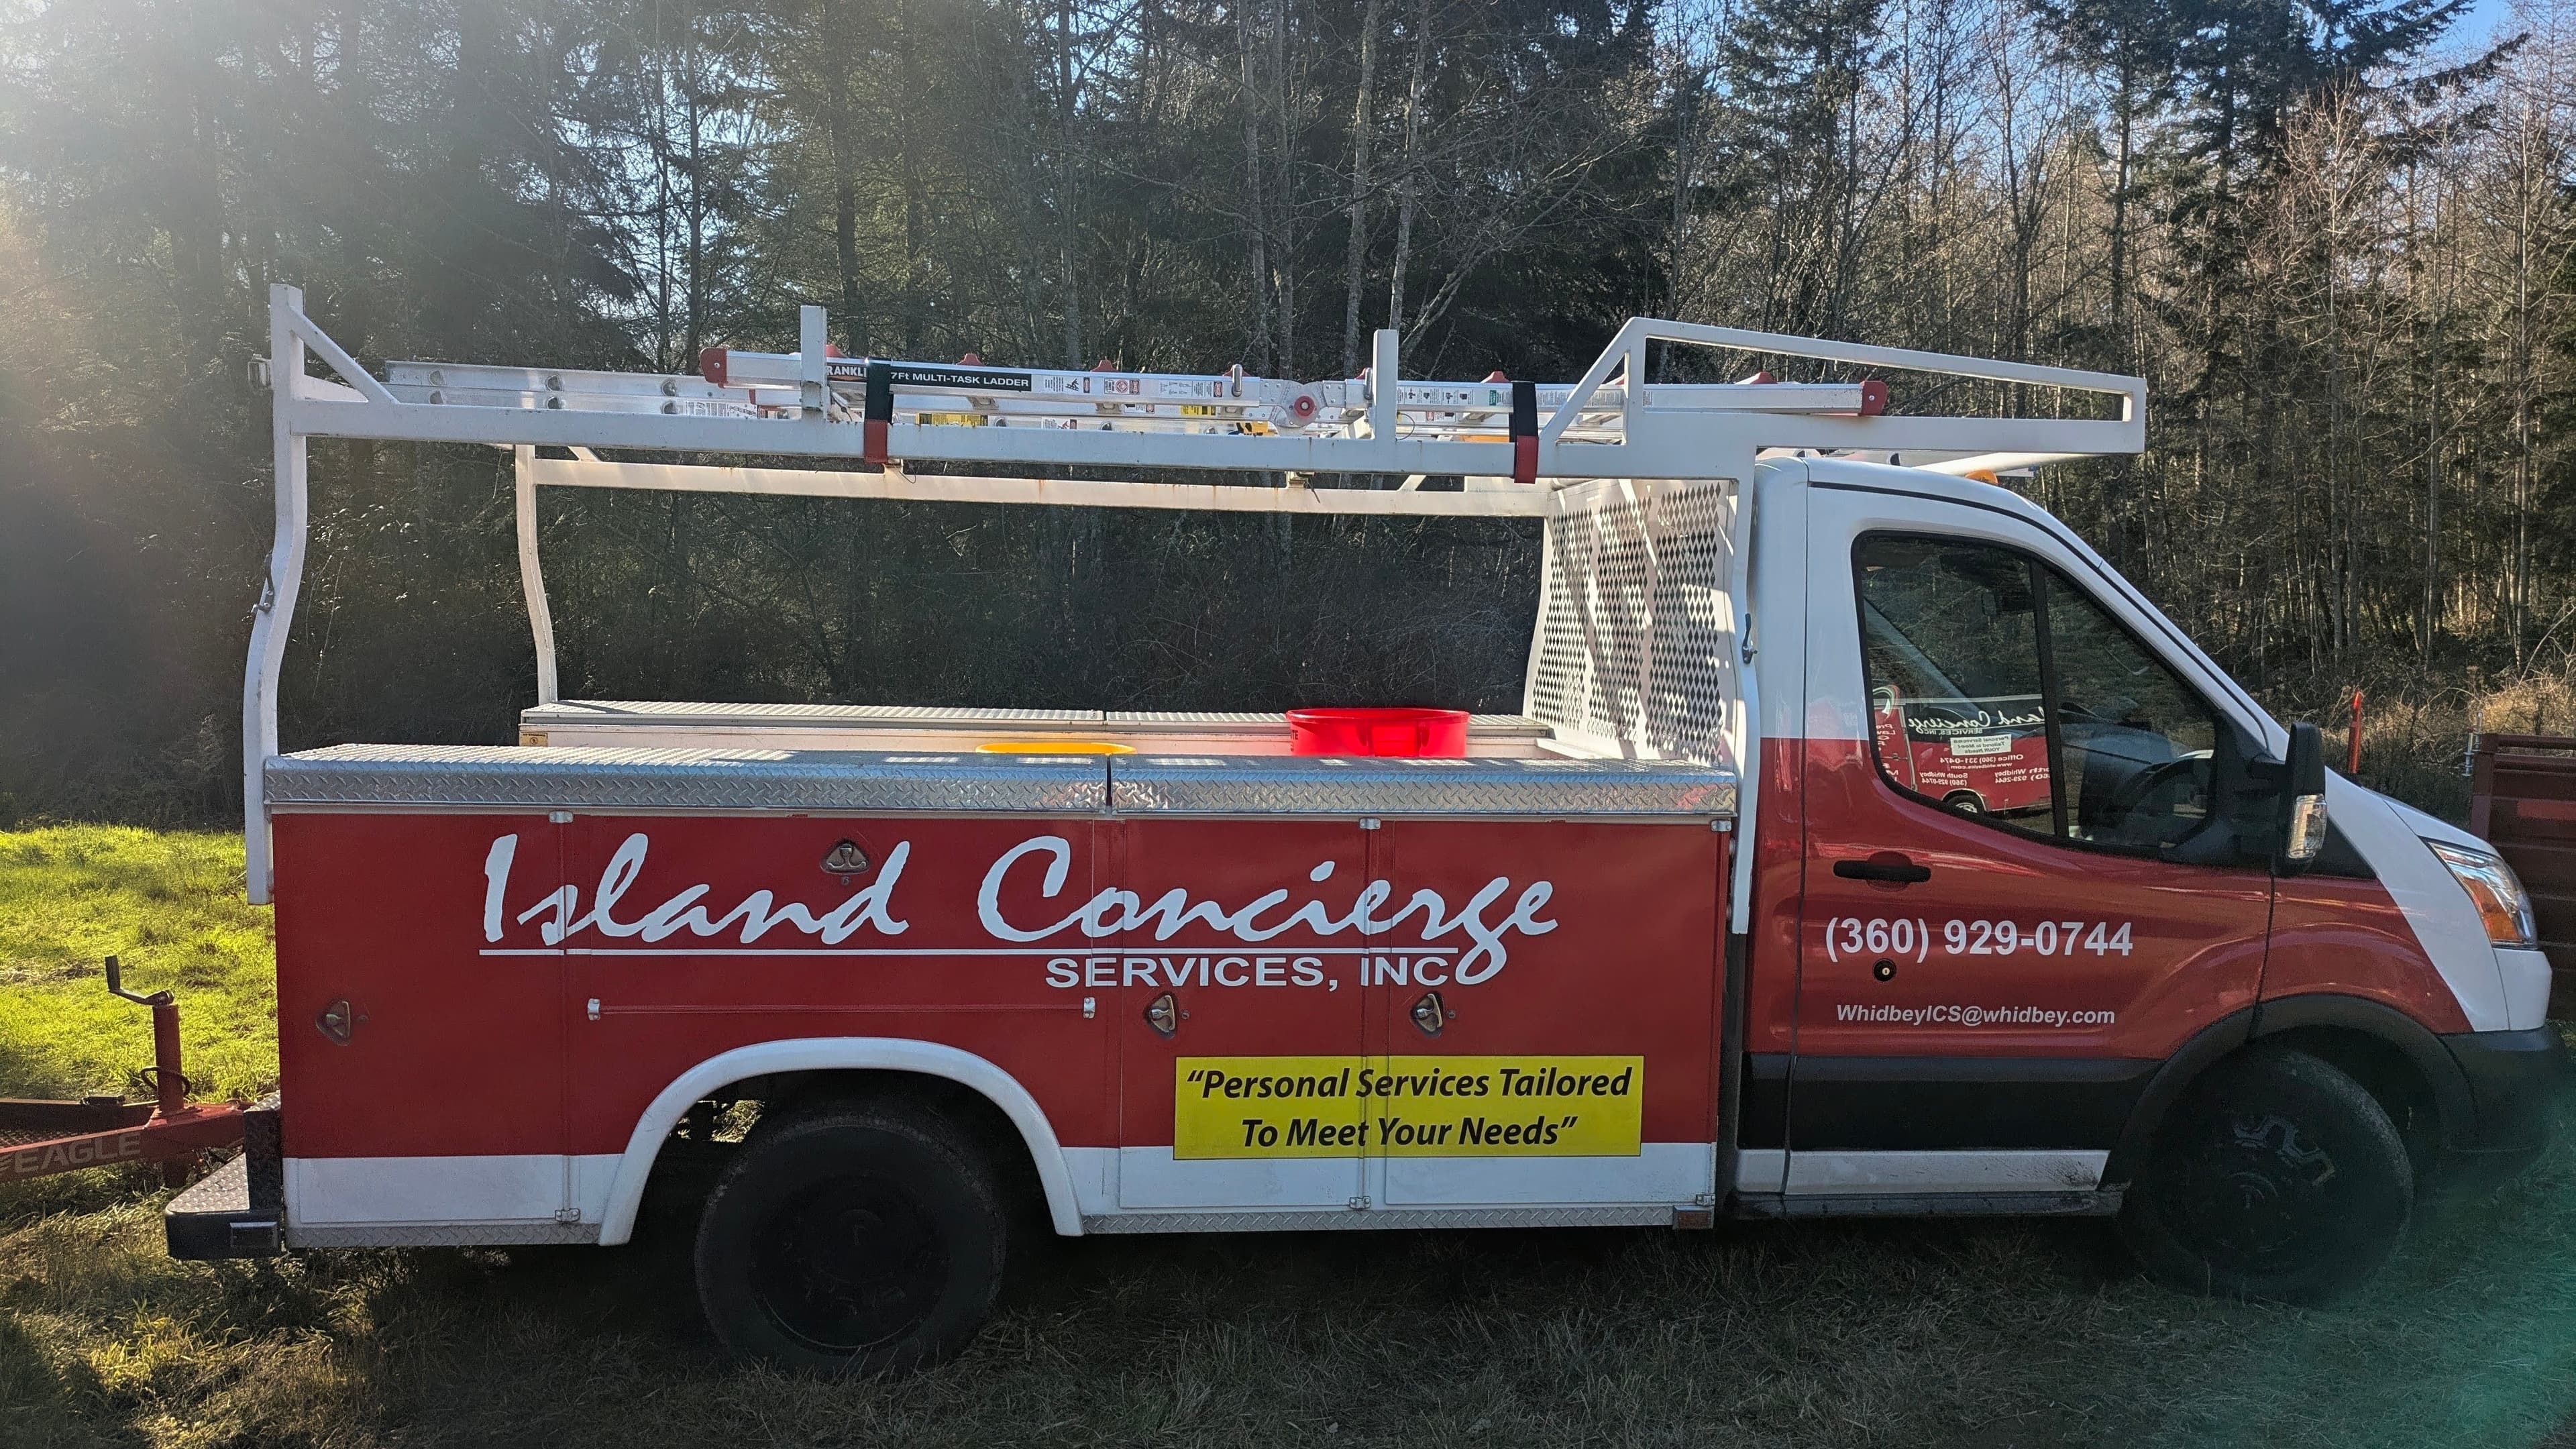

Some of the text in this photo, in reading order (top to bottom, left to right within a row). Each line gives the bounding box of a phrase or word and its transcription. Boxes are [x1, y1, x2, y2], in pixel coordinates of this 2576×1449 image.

[826, 365, 867, 378] RANKLI
[912, 372, 980, 384] MULTI-TASK
[983, 376, 1029, 387] LADDER
[484, 833, 1560, 985] Island Concierge
[1825, 916, 2134, 963] (360) 929-0744
[1045, 957, 1450, 991] SERVICES, INC
[1836, 1004, 2116, 1027] WhidbeyICS@whidbey.com
[1187, 1066, 1633, 1099] “Personal Services Tailored
[1241, 1115, 1578, 1148] To Meet Your Needs”
[14, 1132, 142, 1174] EAGLE
